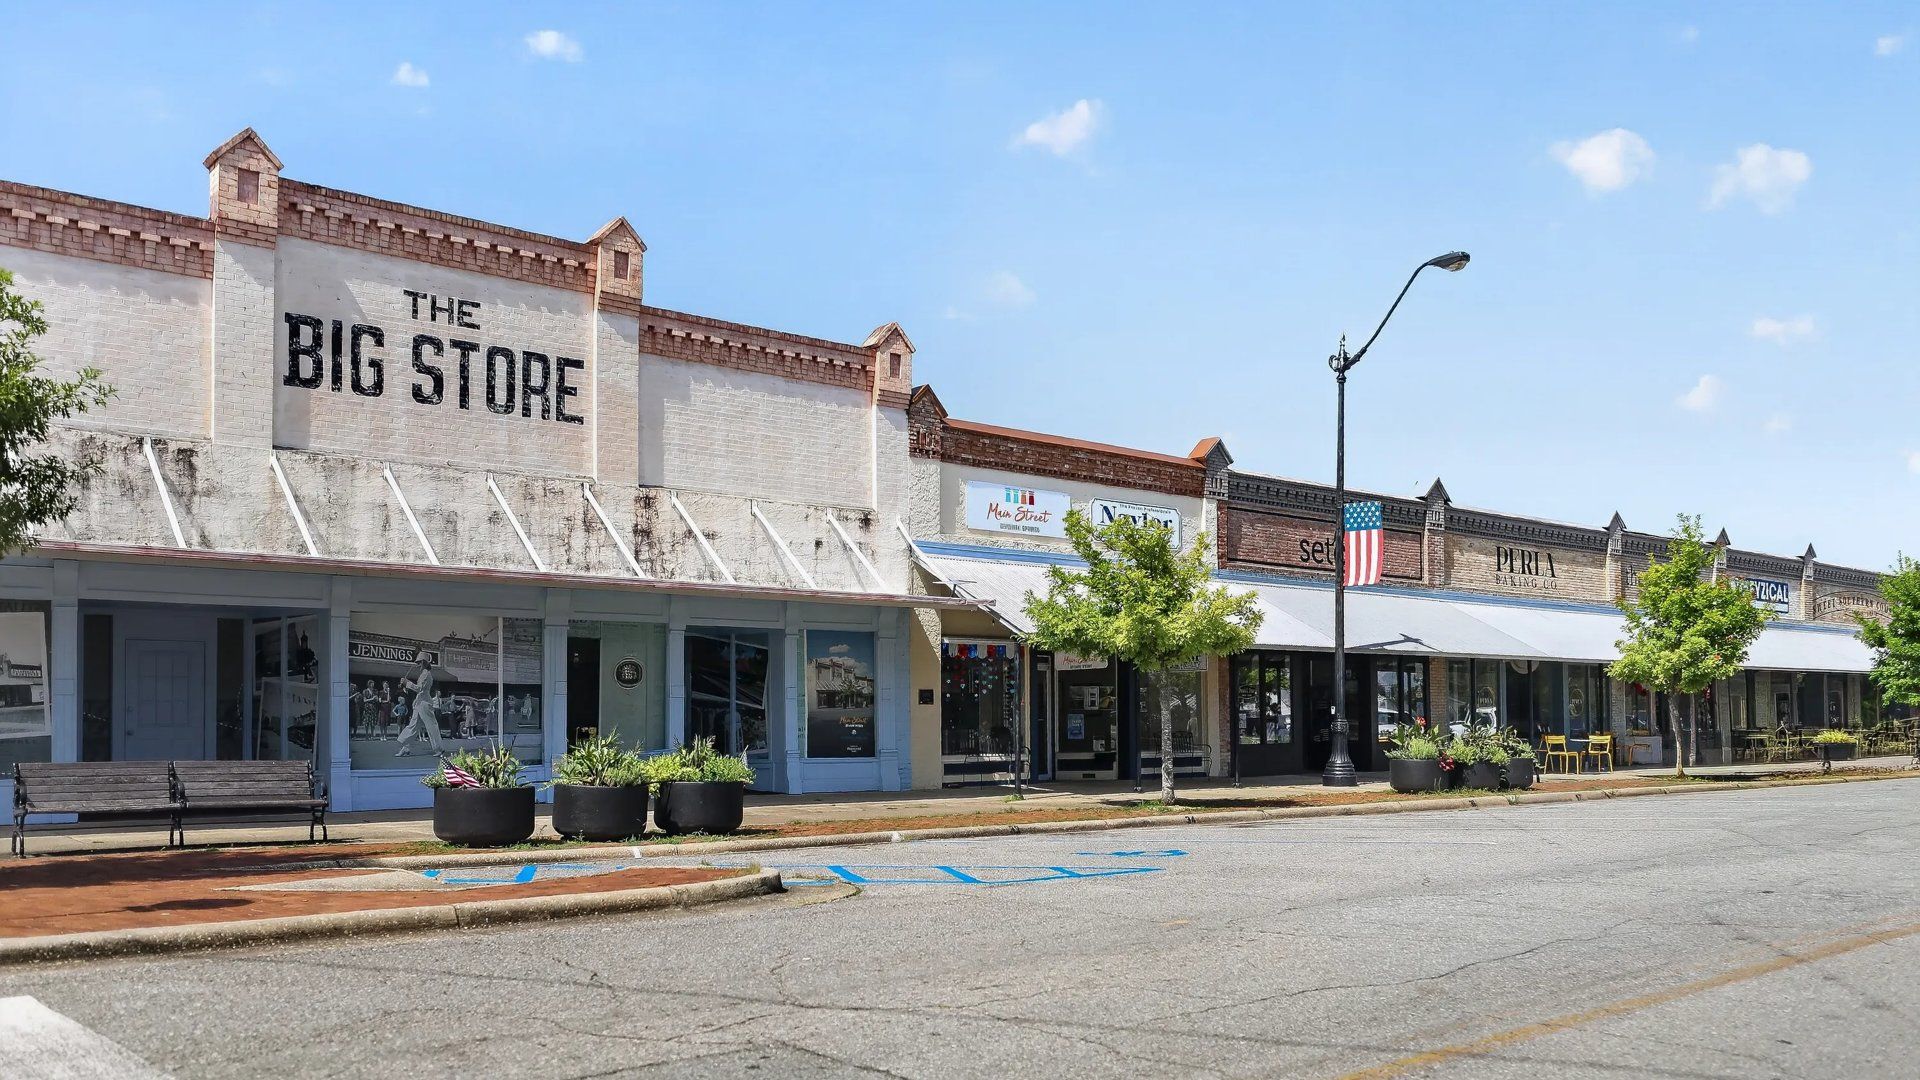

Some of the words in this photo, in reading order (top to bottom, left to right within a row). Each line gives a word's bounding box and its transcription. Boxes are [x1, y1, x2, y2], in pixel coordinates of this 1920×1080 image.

[403, 289, 481, 330] THE
[283, 312, 385, 398] BIG
[411, 334, 585, 425] STORE
[987, 502, 1012, 520] Main
[1014, 506, 1052, 523] Street
[1099, 503, 1173, 528] Nylr
[1495, 545, 1558, 578] PERLA
[1495, 573, 1537, 588] BAKING
[353, 643, 413, 662] JENNINGS
